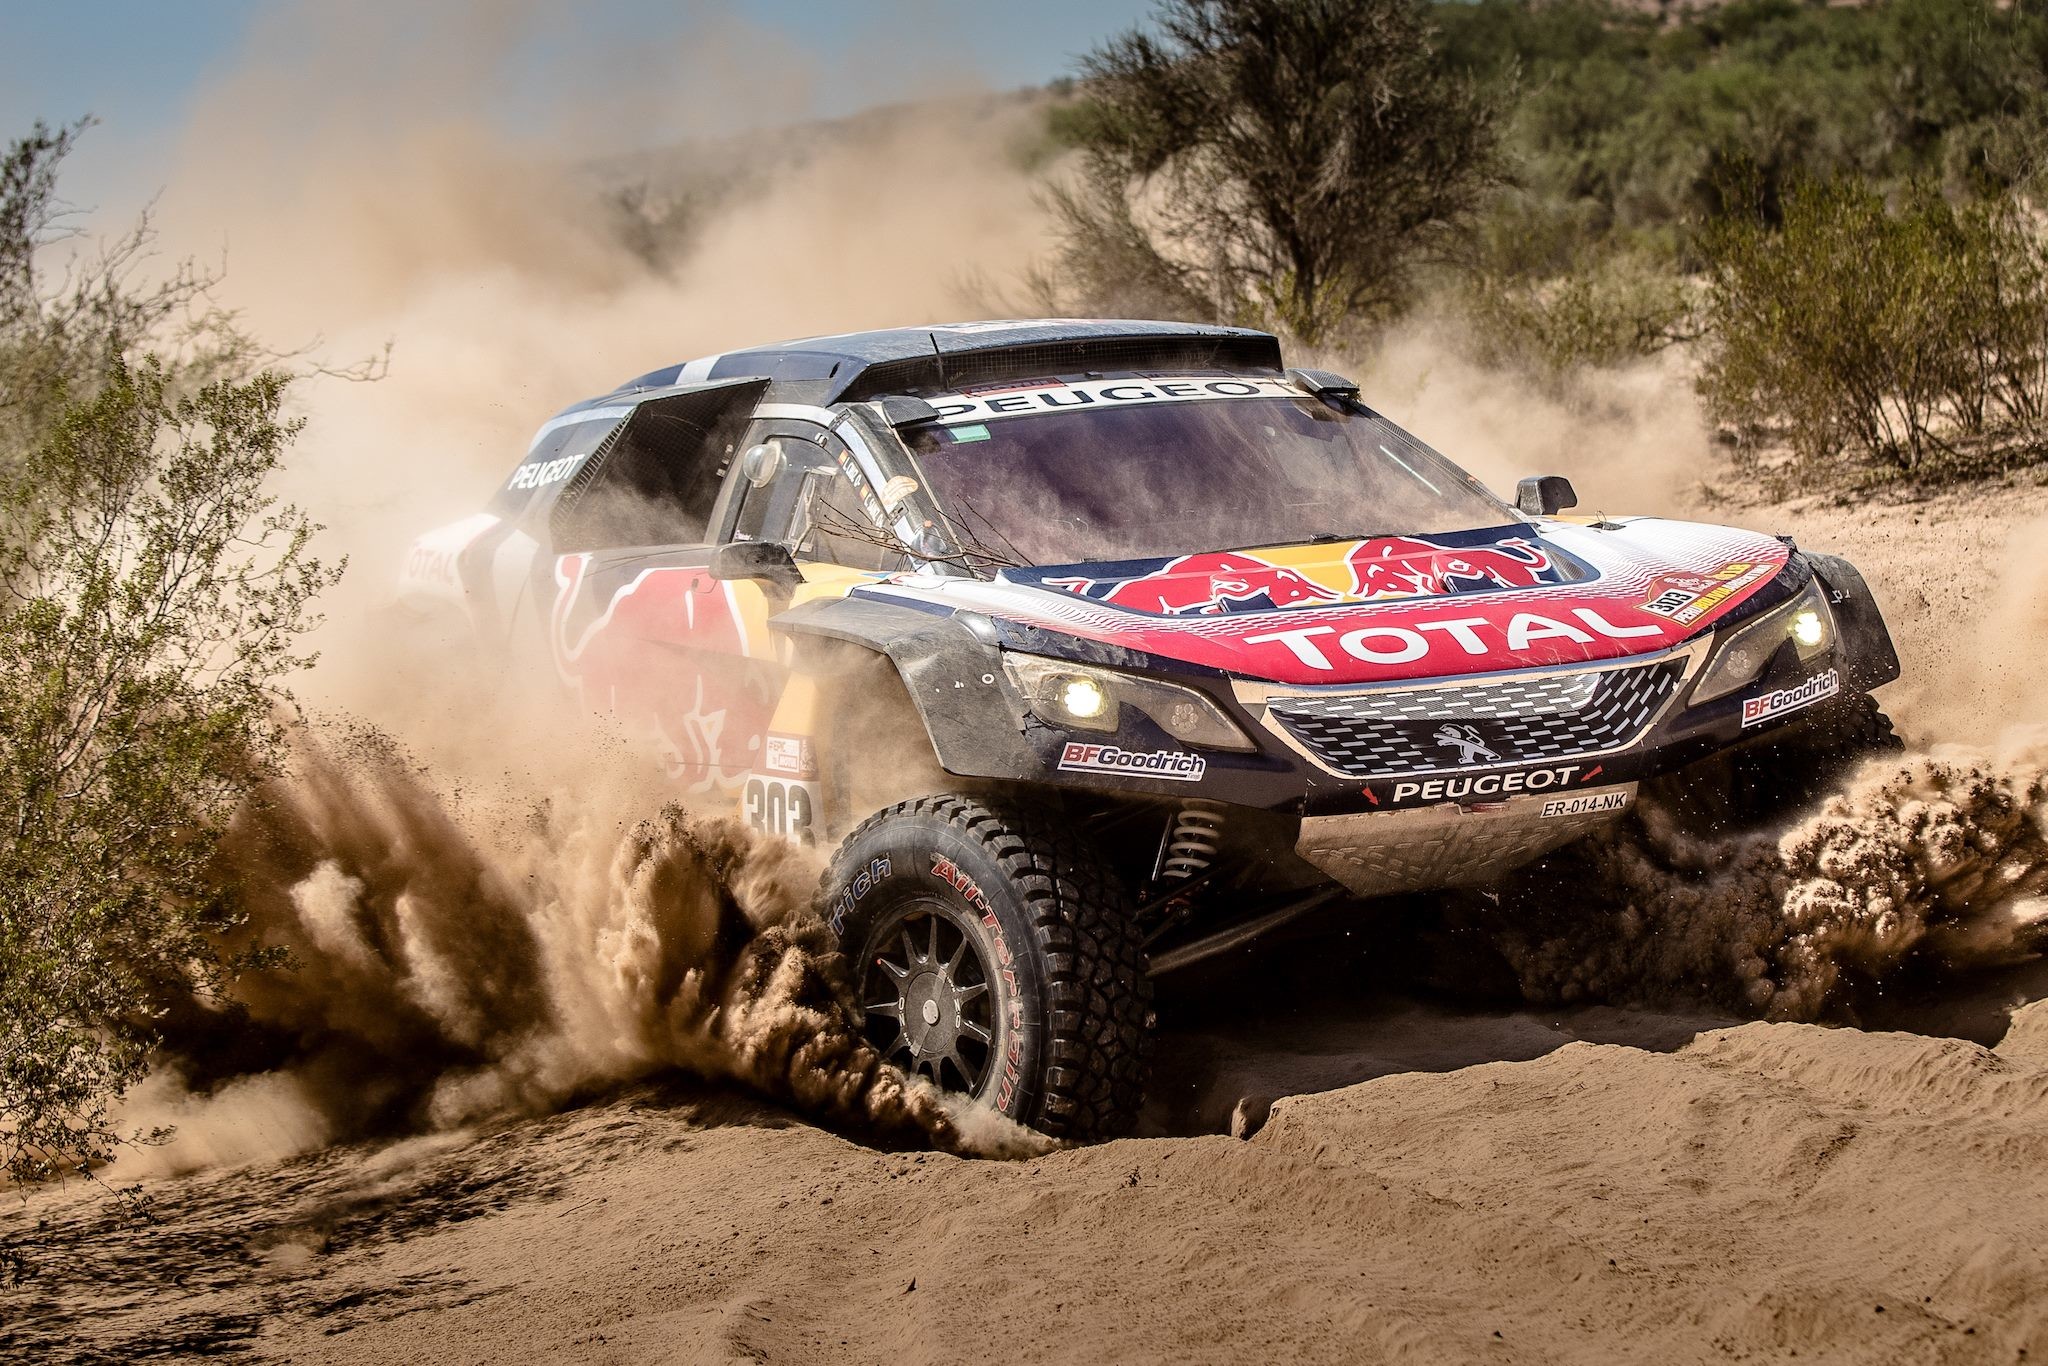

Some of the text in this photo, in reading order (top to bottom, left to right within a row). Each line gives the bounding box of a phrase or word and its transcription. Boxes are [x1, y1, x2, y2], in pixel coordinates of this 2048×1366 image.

[507, 453, 586, 490] PEUGEOT
[1647, 591, 1693, 612] 303
[1242, 607, 1664, 671] TOTAL
[1744, 670, 1838, 719] BFGoodrich
[1063, 744, 1205, 773] BFGoodrich
[1392, 766, 1580, 803] PEUGEOT
[746, 779, 816, 849] 303
[1542, 793, 1627, 817] ER-014-NK
